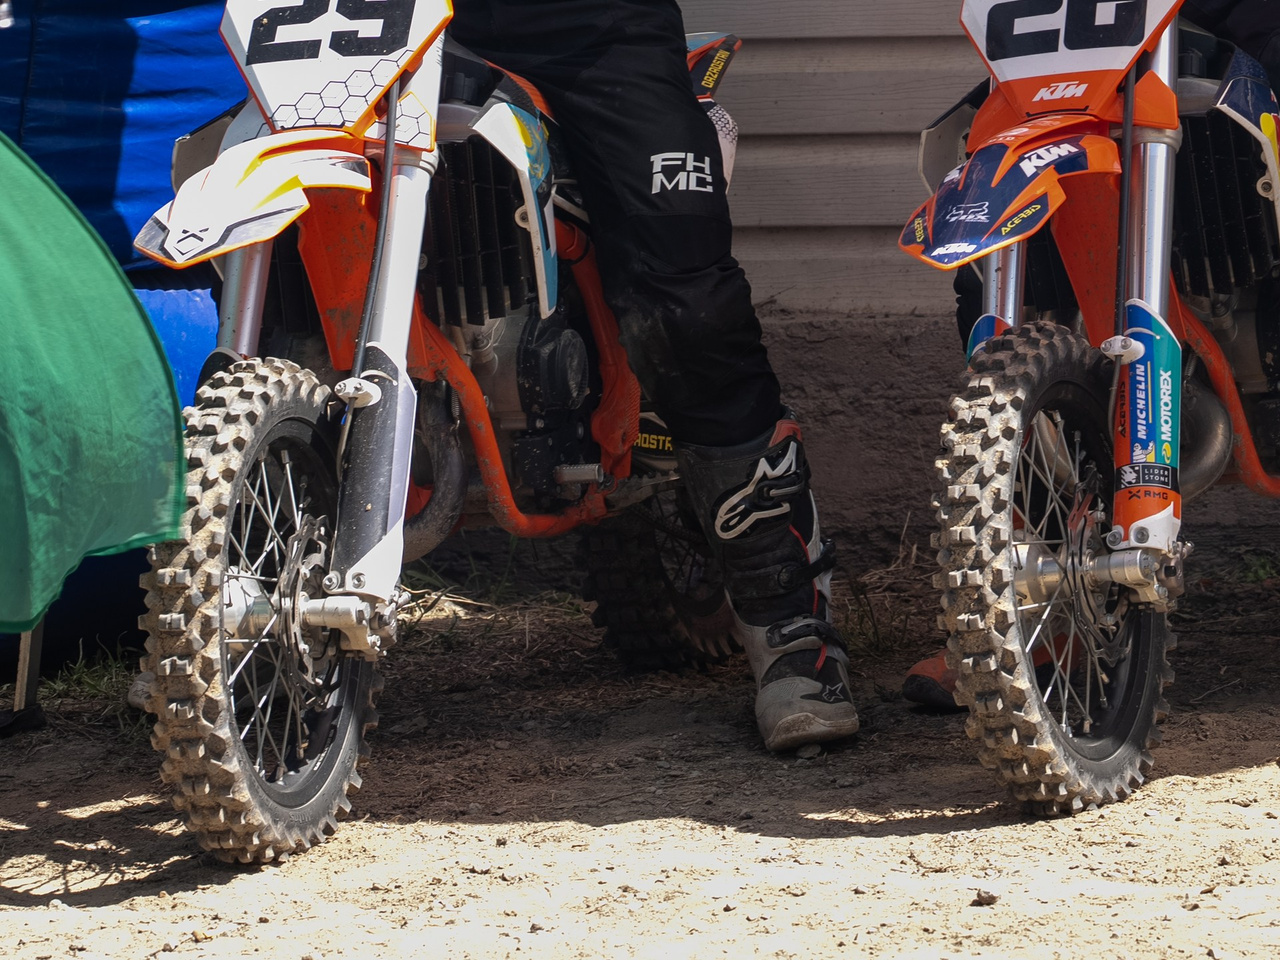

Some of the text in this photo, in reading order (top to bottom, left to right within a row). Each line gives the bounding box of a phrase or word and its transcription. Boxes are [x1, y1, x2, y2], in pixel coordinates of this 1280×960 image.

[1032, 81, 1088, 102] KTM
[1019, 142, 1080, 178] KTM
[651, 171, 714, 195] MC
[1001, 204, 1041, 236] ACERBIS
[931, 242, 977, 257] KTM
[1136, 362, 1146, 440] MICHELIN
[1160, 369, 1173, 442] MOTOREX
[1144, 468, 1169, 476] LIDER
[1144, 475, 1169, 483] STONE
